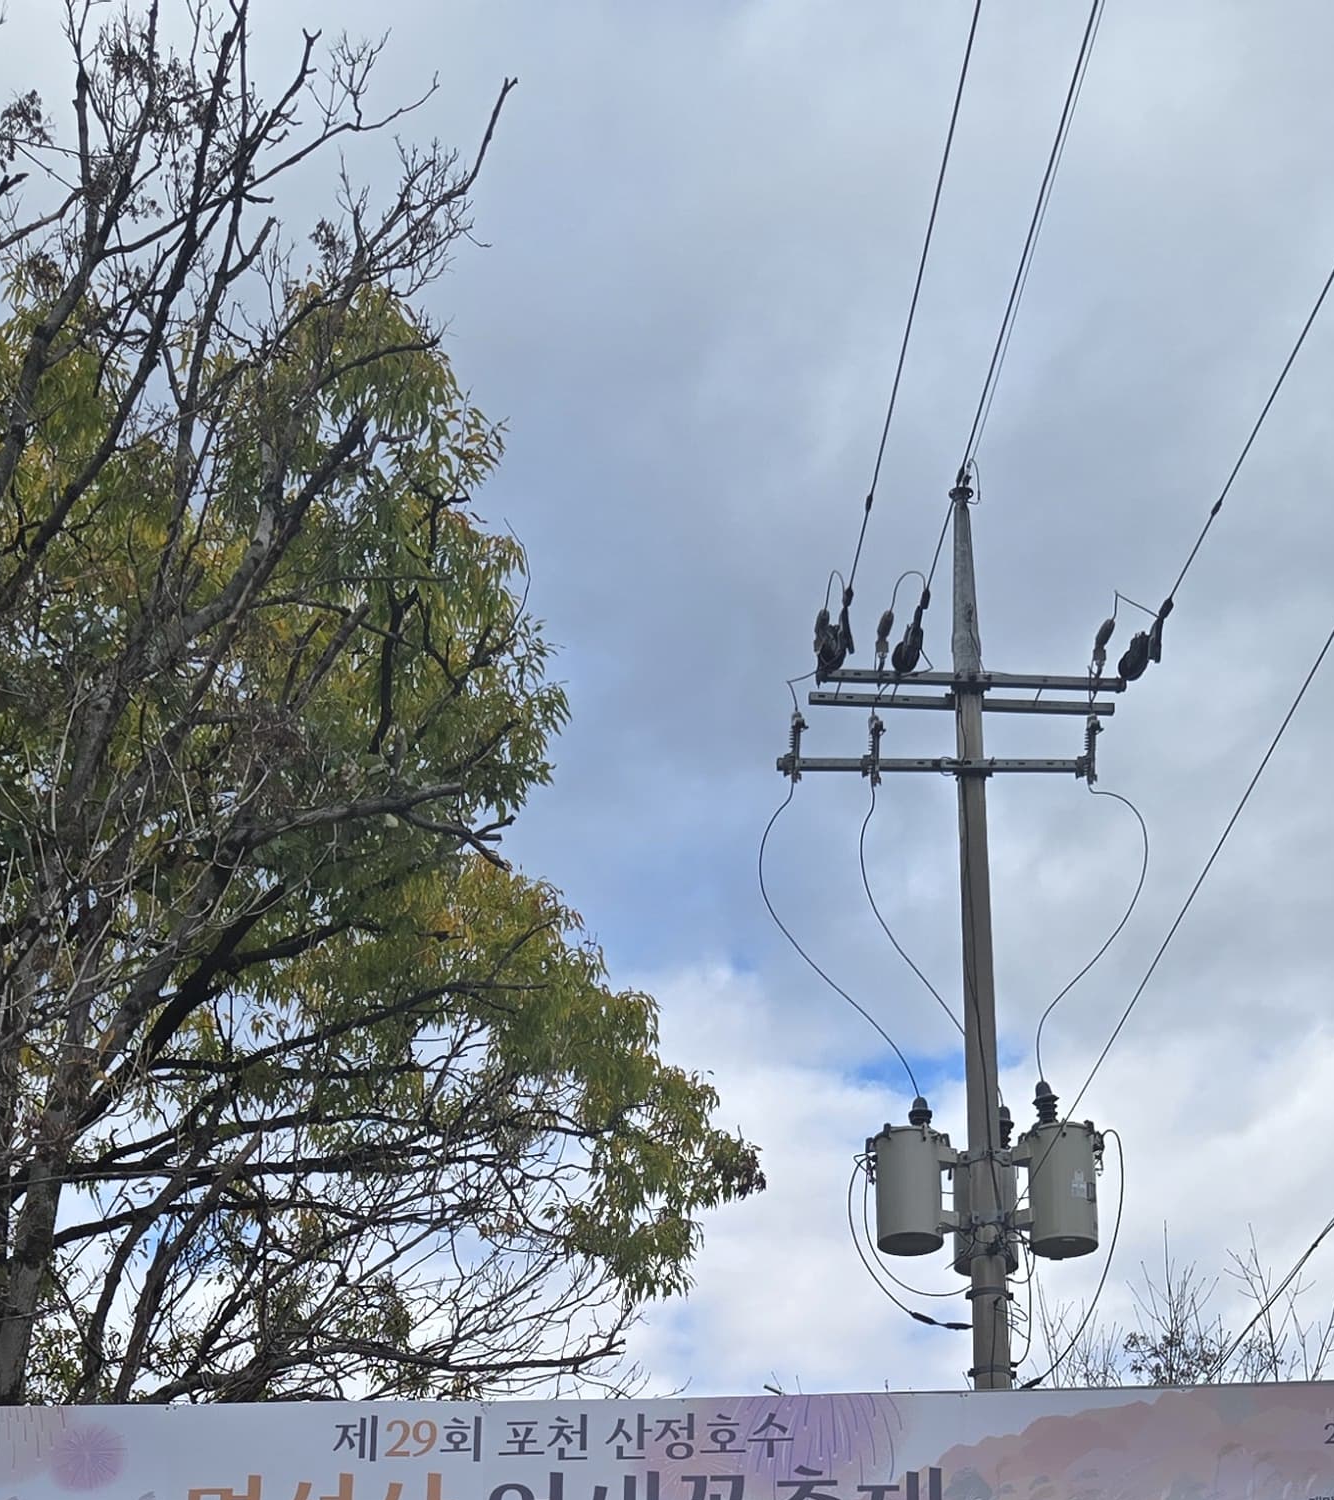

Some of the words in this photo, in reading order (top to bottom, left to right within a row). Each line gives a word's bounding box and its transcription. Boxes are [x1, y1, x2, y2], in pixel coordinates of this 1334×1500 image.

[333, 1413, 483, 1464] 제29회
[497, 1413, 589, 1461] 포천
[605, 1411, 794, 1460] 산정호수
